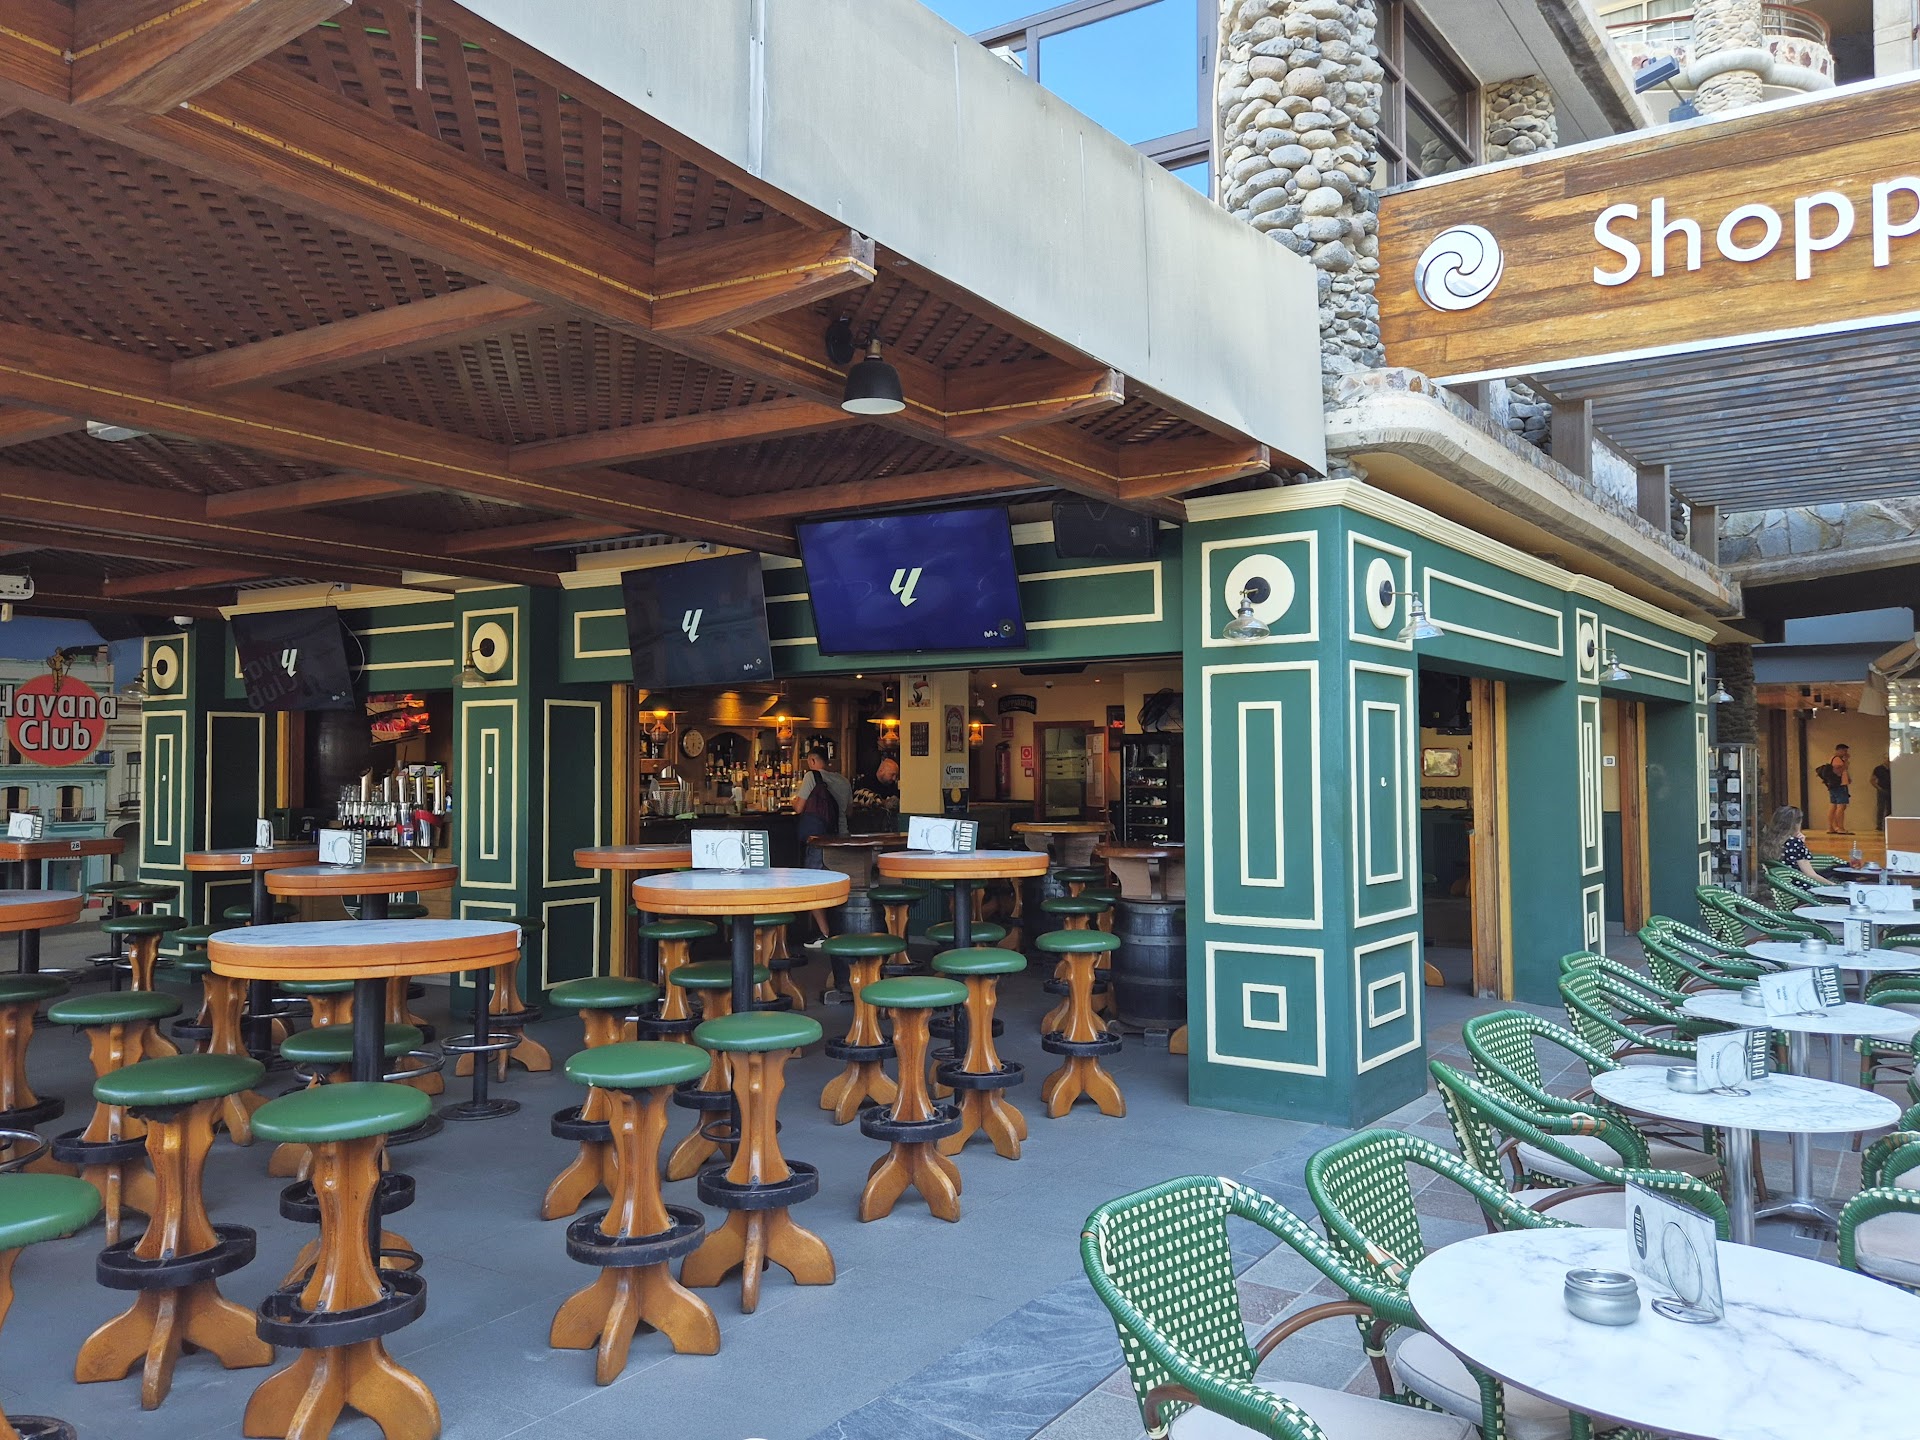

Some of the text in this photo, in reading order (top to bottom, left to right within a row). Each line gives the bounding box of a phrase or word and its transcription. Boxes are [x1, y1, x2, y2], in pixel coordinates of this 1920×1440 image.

[1593, 176, 1920, 286] Shopp
[0, 683, 118, 720] Havana
[18, 719, 92, 751] Club
[946, 765, 965, 776] Corona
[72, 842, 80, 850] 28
[749, 833, 765, 867] HAVANA
[1820, 967, 1841, 1005] HAVANA
[1752, 1031, 1767, 1077] HAVANA
